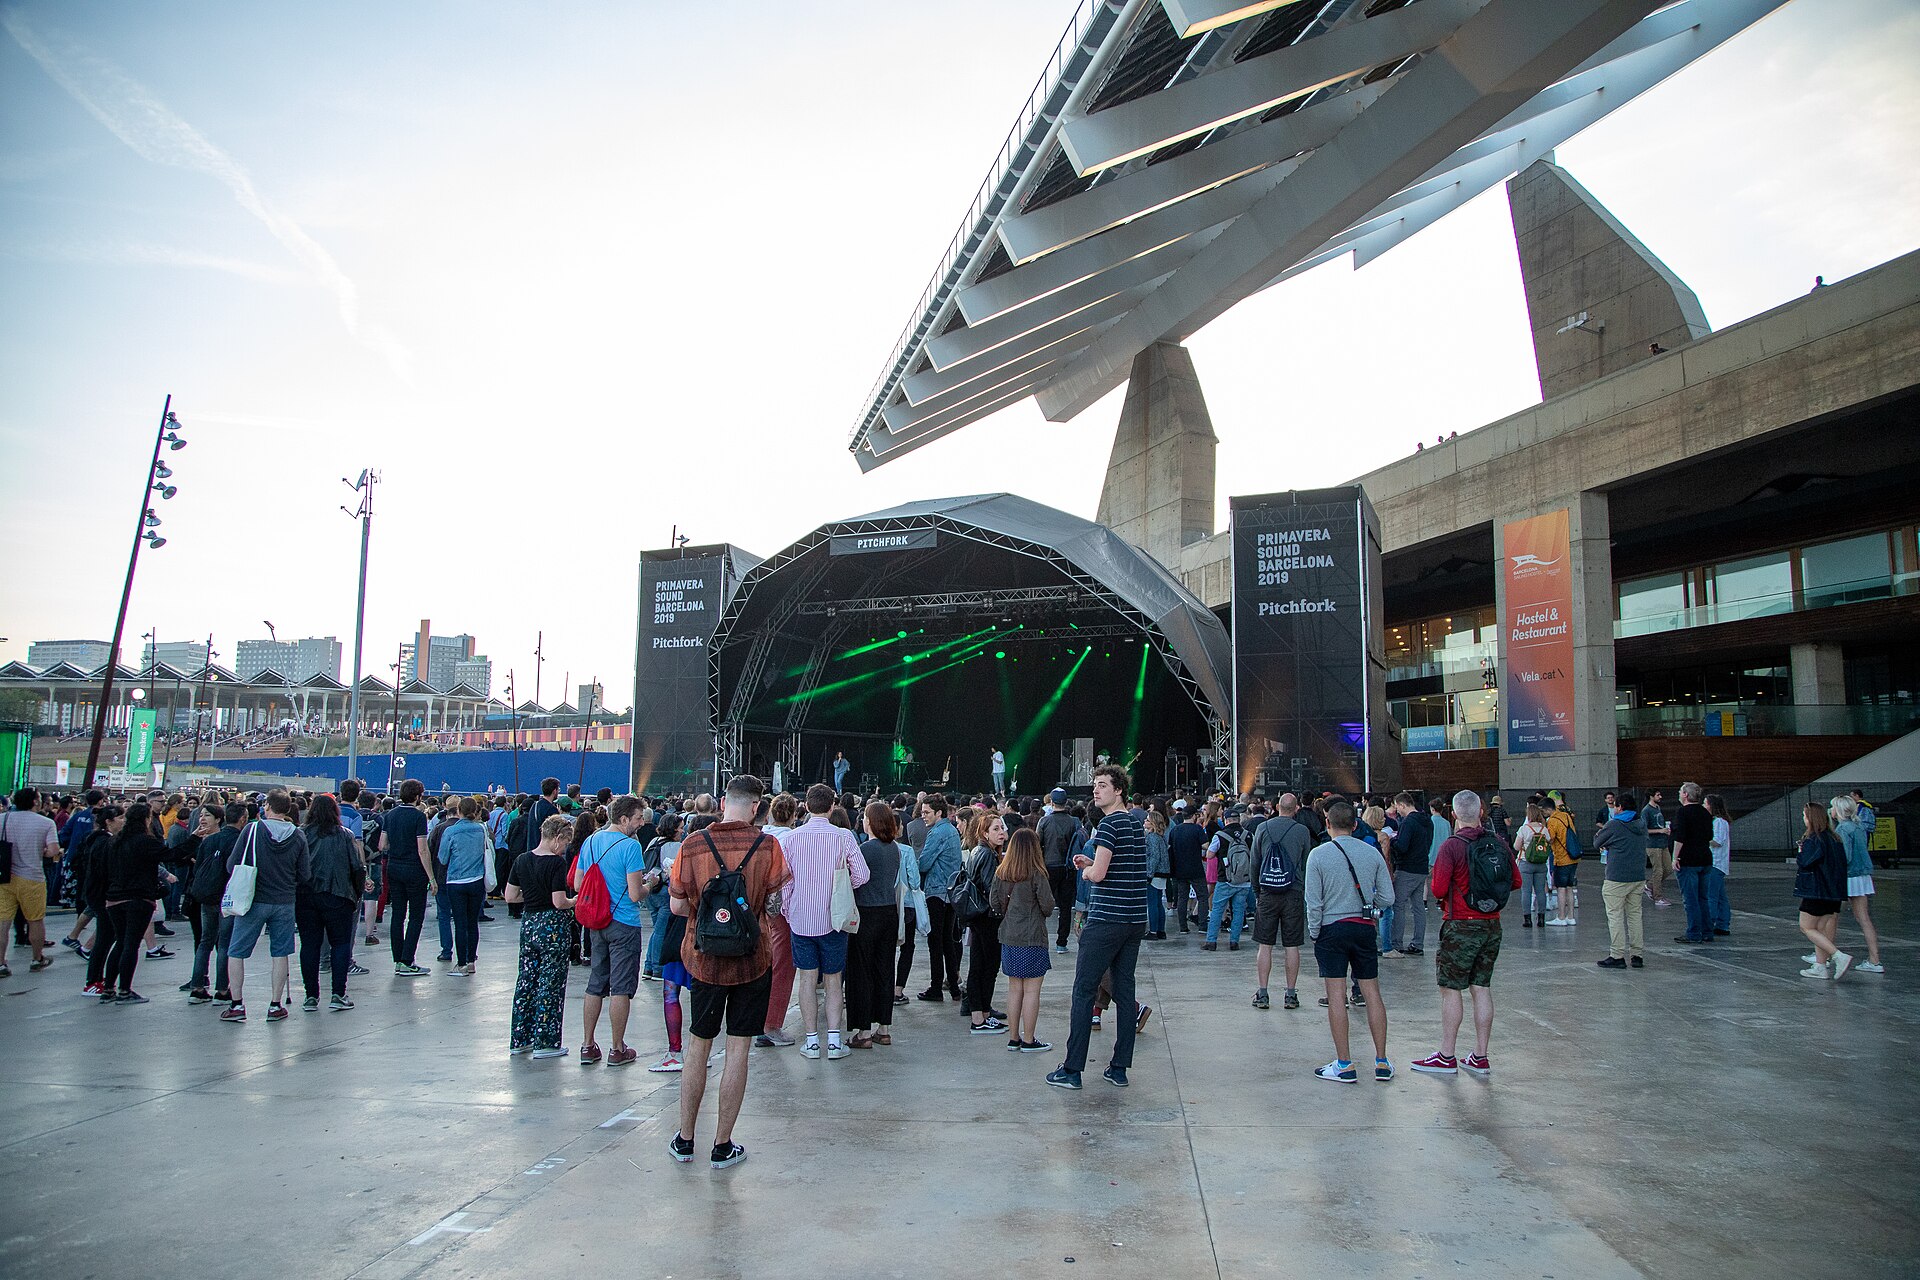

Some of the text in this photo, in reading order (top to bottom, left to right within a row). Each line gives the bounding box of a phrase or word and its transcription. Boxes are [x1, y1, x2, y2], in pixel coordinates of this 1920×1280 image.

[857, 535, 909, 549] PITCHFORK
[1257, 528, 1331, 546] PRIMAVERA
[1257, 543, 1300, 559] SOUND
[1258, 555, 1335, 572] BARCELONA
[655, 579, 704, 591] PRIMAVERA
[1258, 571, 1289, 585] 2019
[655, 591, 684, 602] SOUND
[654, 601, 705, 613] BARCELONA
[1258, 599, 1336, 616] Pitchfork
[654, 613, 675, 624] 2019
[1516, 607, 1559, 626] Hostel &
[1512, 621, 1567, 641] Restaurant
[652, 636, 704, 648] Pitchfork
[1521, 669, 1556, 683] Vela.cat
[137, 731, 147, 763] Heineken
